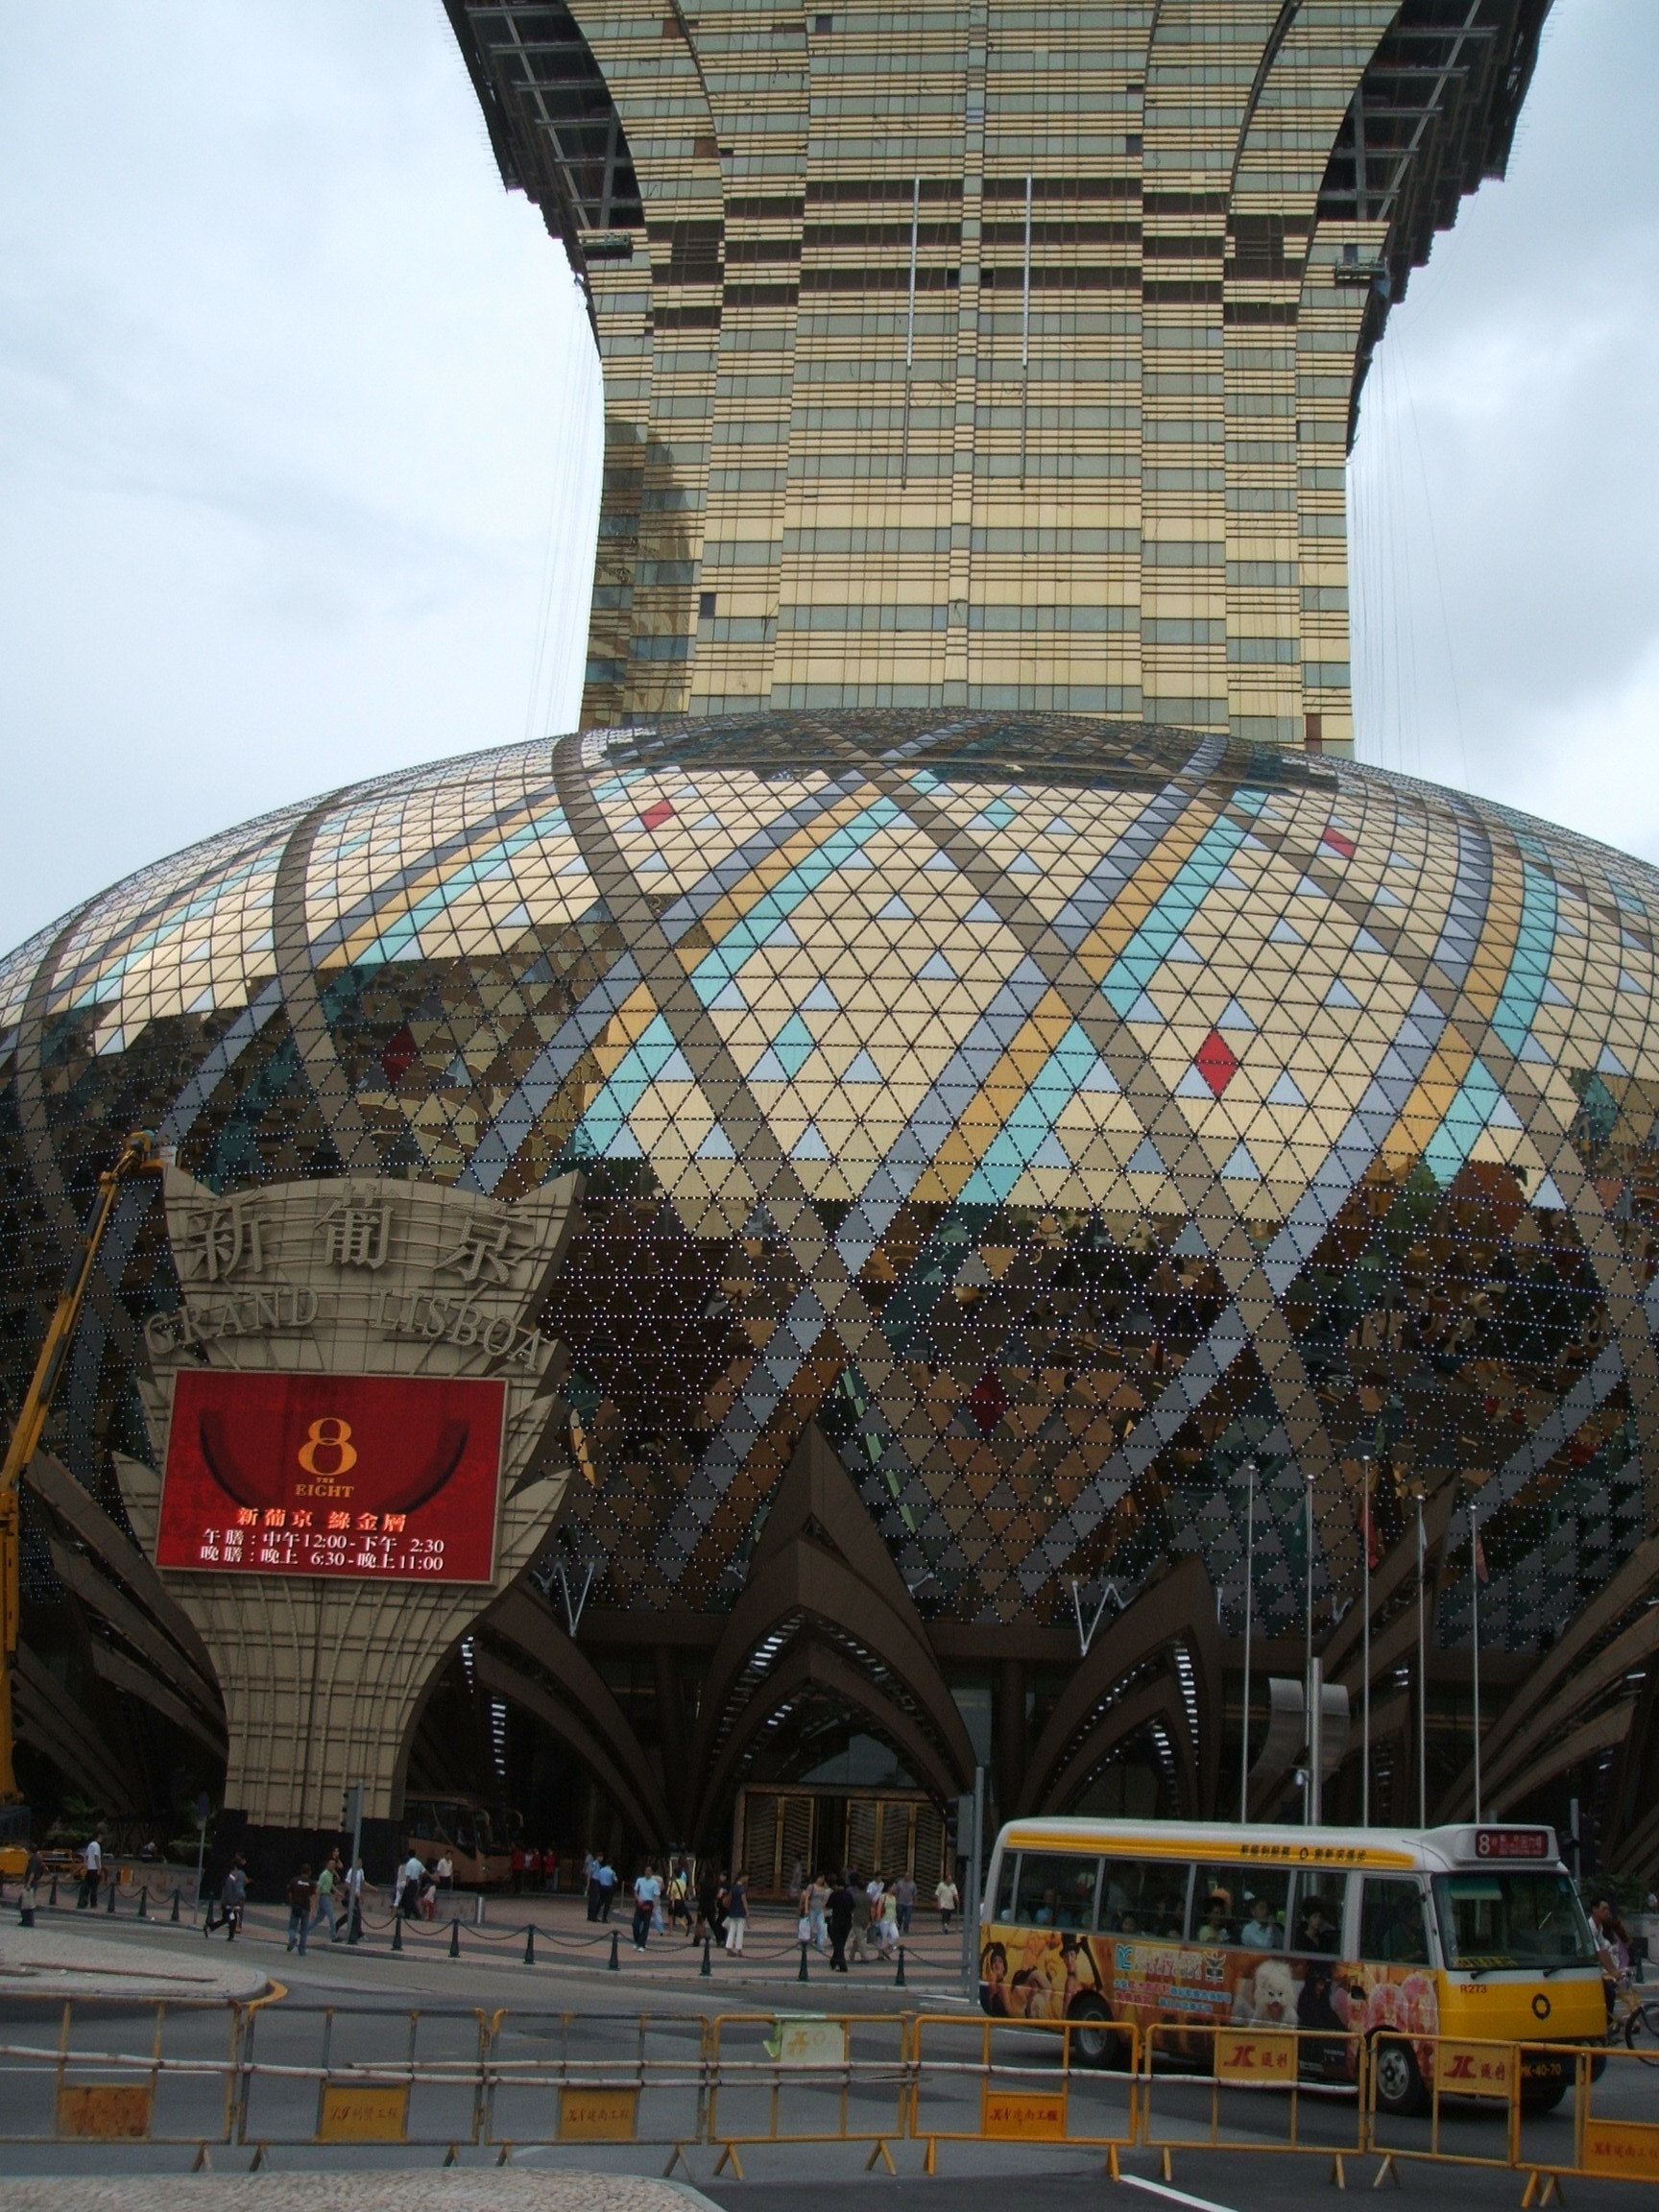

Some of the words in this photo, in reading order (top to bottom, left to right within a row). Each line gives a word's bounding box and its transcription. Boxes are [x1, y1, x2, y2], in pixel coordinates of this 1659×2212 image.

[189, 1183, 535, 1284] 新葡京
[144, 1286, 319, 1355] GRAND
[371, 1288, 543, 1372] LISBOA
[298, 1417, 357, 1476] 8
[295, 1484, 355, 1498] EIGHT
[237, 1506, 314, 1527] 新葡京
[410, 1539, 445, 1554] 2:30
[1479, 1834, 1490, 1854] 8
[1459, 1984, 1487, 1994] R273
